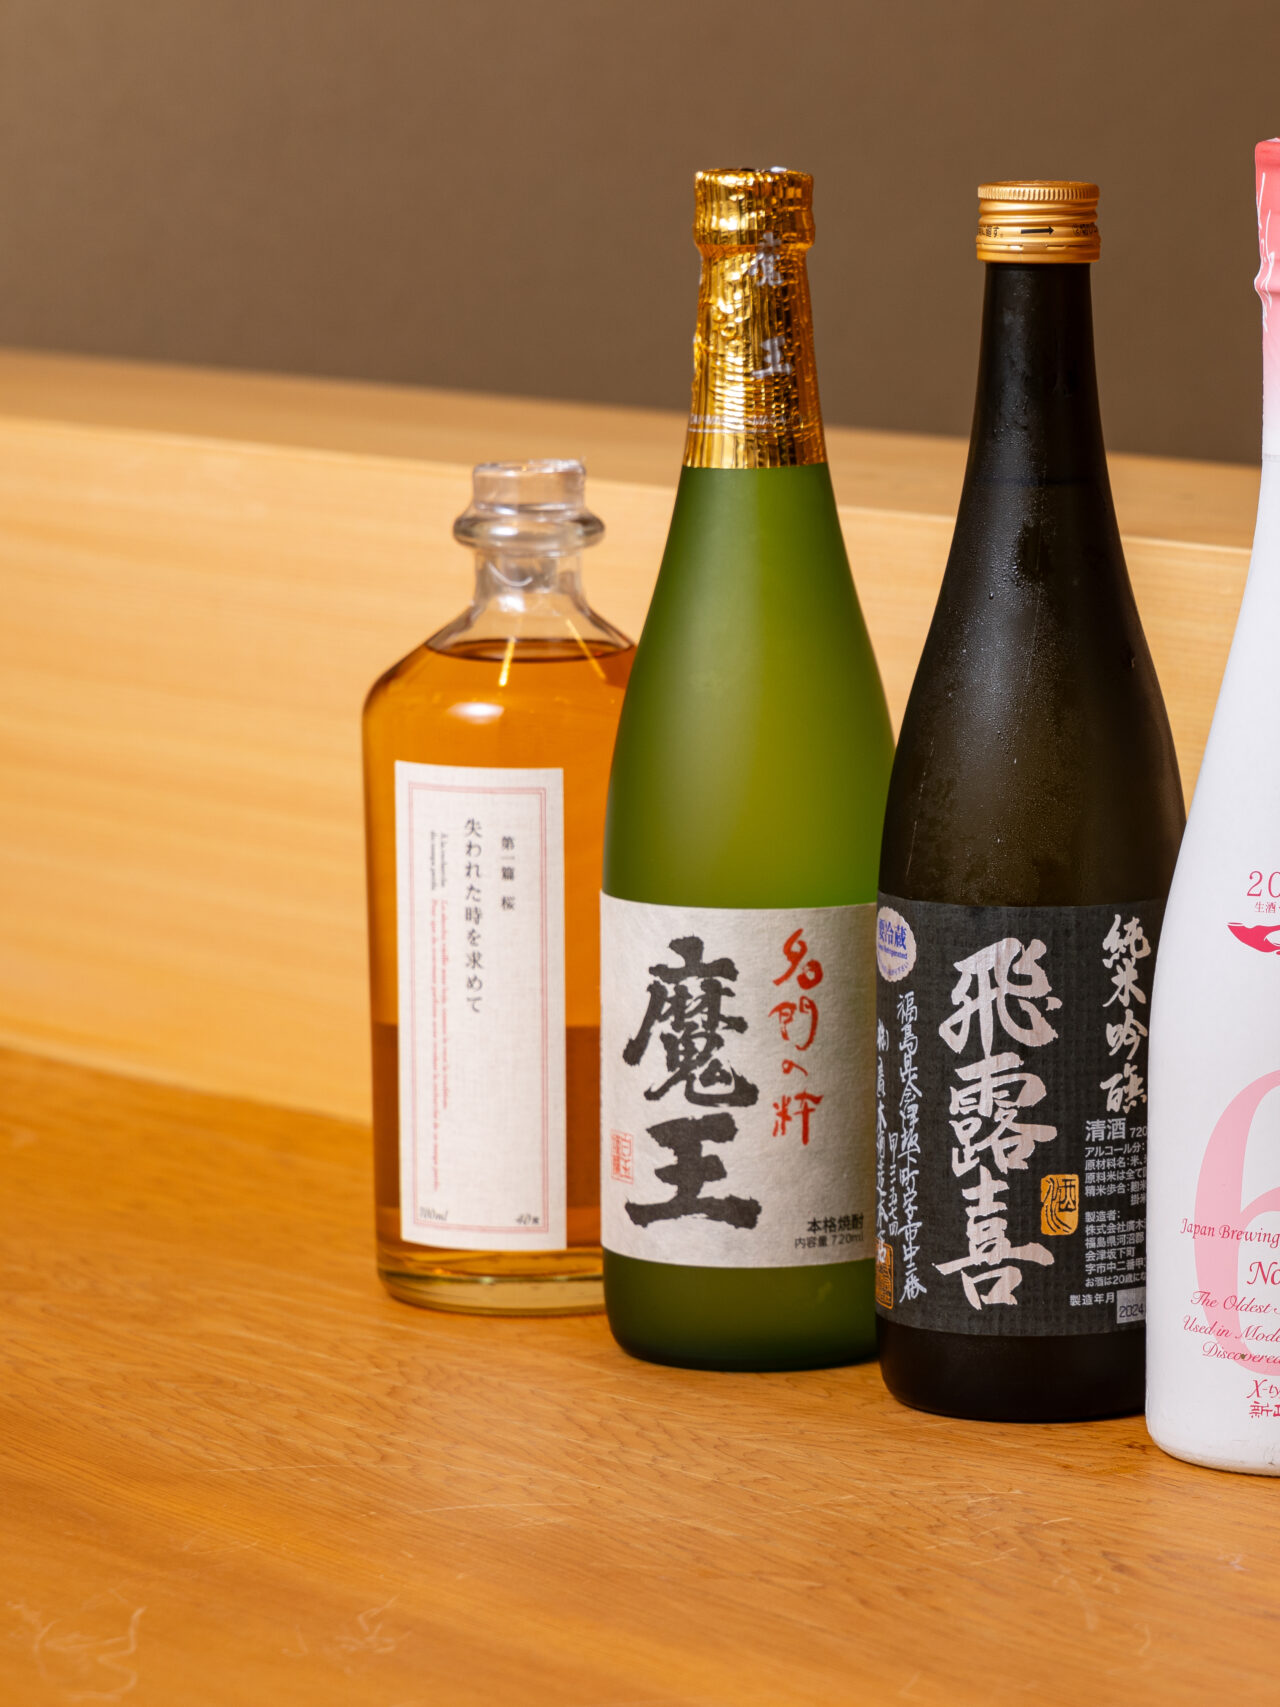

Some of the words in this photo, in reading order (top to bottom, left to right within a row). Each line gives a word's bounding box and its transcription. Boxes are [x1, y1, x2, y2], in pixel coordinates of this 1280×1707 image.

[465, 818, 483, 1014] 失われた時を求めて
[622, 936, 763, 1230] 魔王
[931, 937, 1063, 1310] 飛露喜
[1085, 1118, 1126, 1142] 清酒
[807, 1213, 864, 1234] 本格焼酎
[1085, 1219, 1147, 1236] 株式会社廣木
[1180, 1218, 1215, 1239] Japan
[1218, 1224, 1280, 1248] Brewing
[1085, 1232, 1145, 1249] 福島県河沼郡
[1085, 1246, 1136, 1262] 会津坂下町
[1085, 1257, 1147, 1275] 字市中二番甲
[1069, 1292, 1115, 1307] 製造年月
[1190, 1290, 1219, 1308] The
[1223, 1295, 1272, 1314] Oldest
[1183, 1315, 1218, 1336] Used
[1214, 1326, 1232, 1338] in
